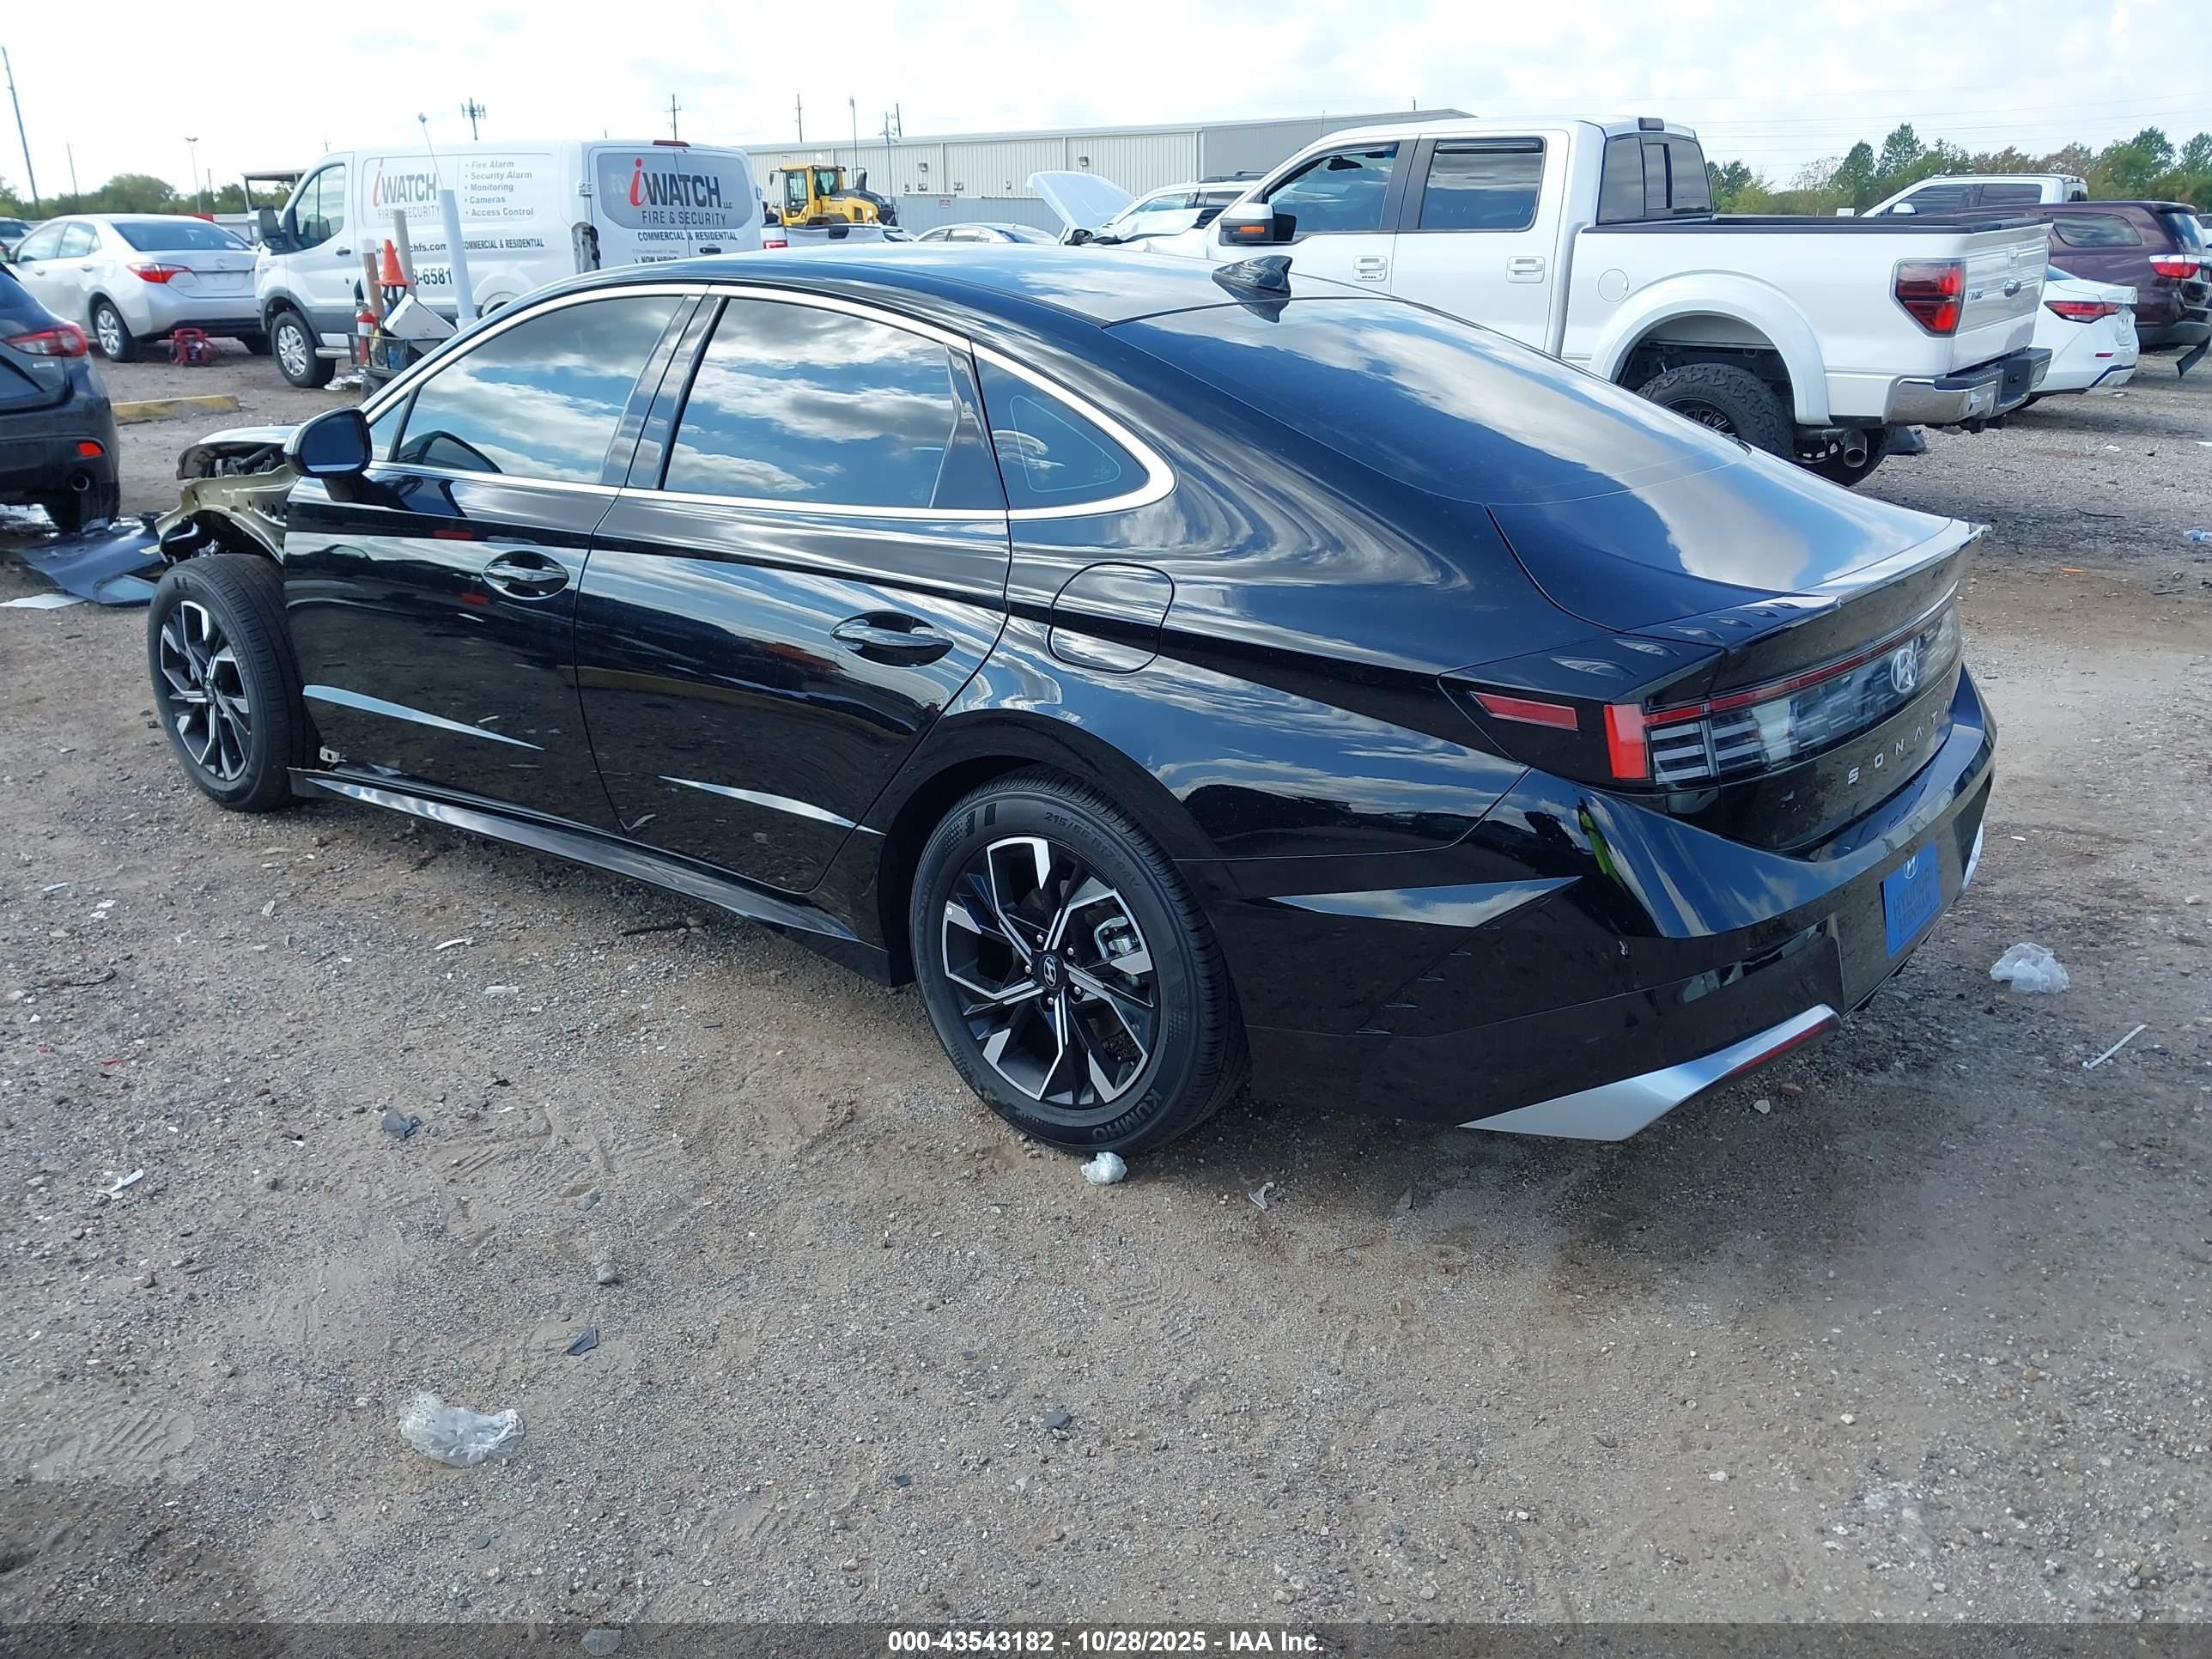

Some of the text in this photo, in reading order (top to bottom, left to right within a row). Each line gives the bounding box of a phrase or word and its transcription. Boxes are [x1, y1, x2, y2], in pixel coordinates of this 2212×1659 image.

[470, 171, 532, 181] Security Alarm
[470, 183, 514, 192] Monitoring
[470, 196, 506, 204] Cameras
[502, 207, 533, 216] Control
[641, 210, 726, 226] FIRE & SECURITY
[637, 231, 738, 241] COMMERCIAL & RESIDENTIAL
[500, 239, 504, 248] &
[505, 238, 544, 248] RESIDENTIAL
[1847, 700, 1950, 785] SONATA
[1091, 1088, 1164, 1141] KUMHO
